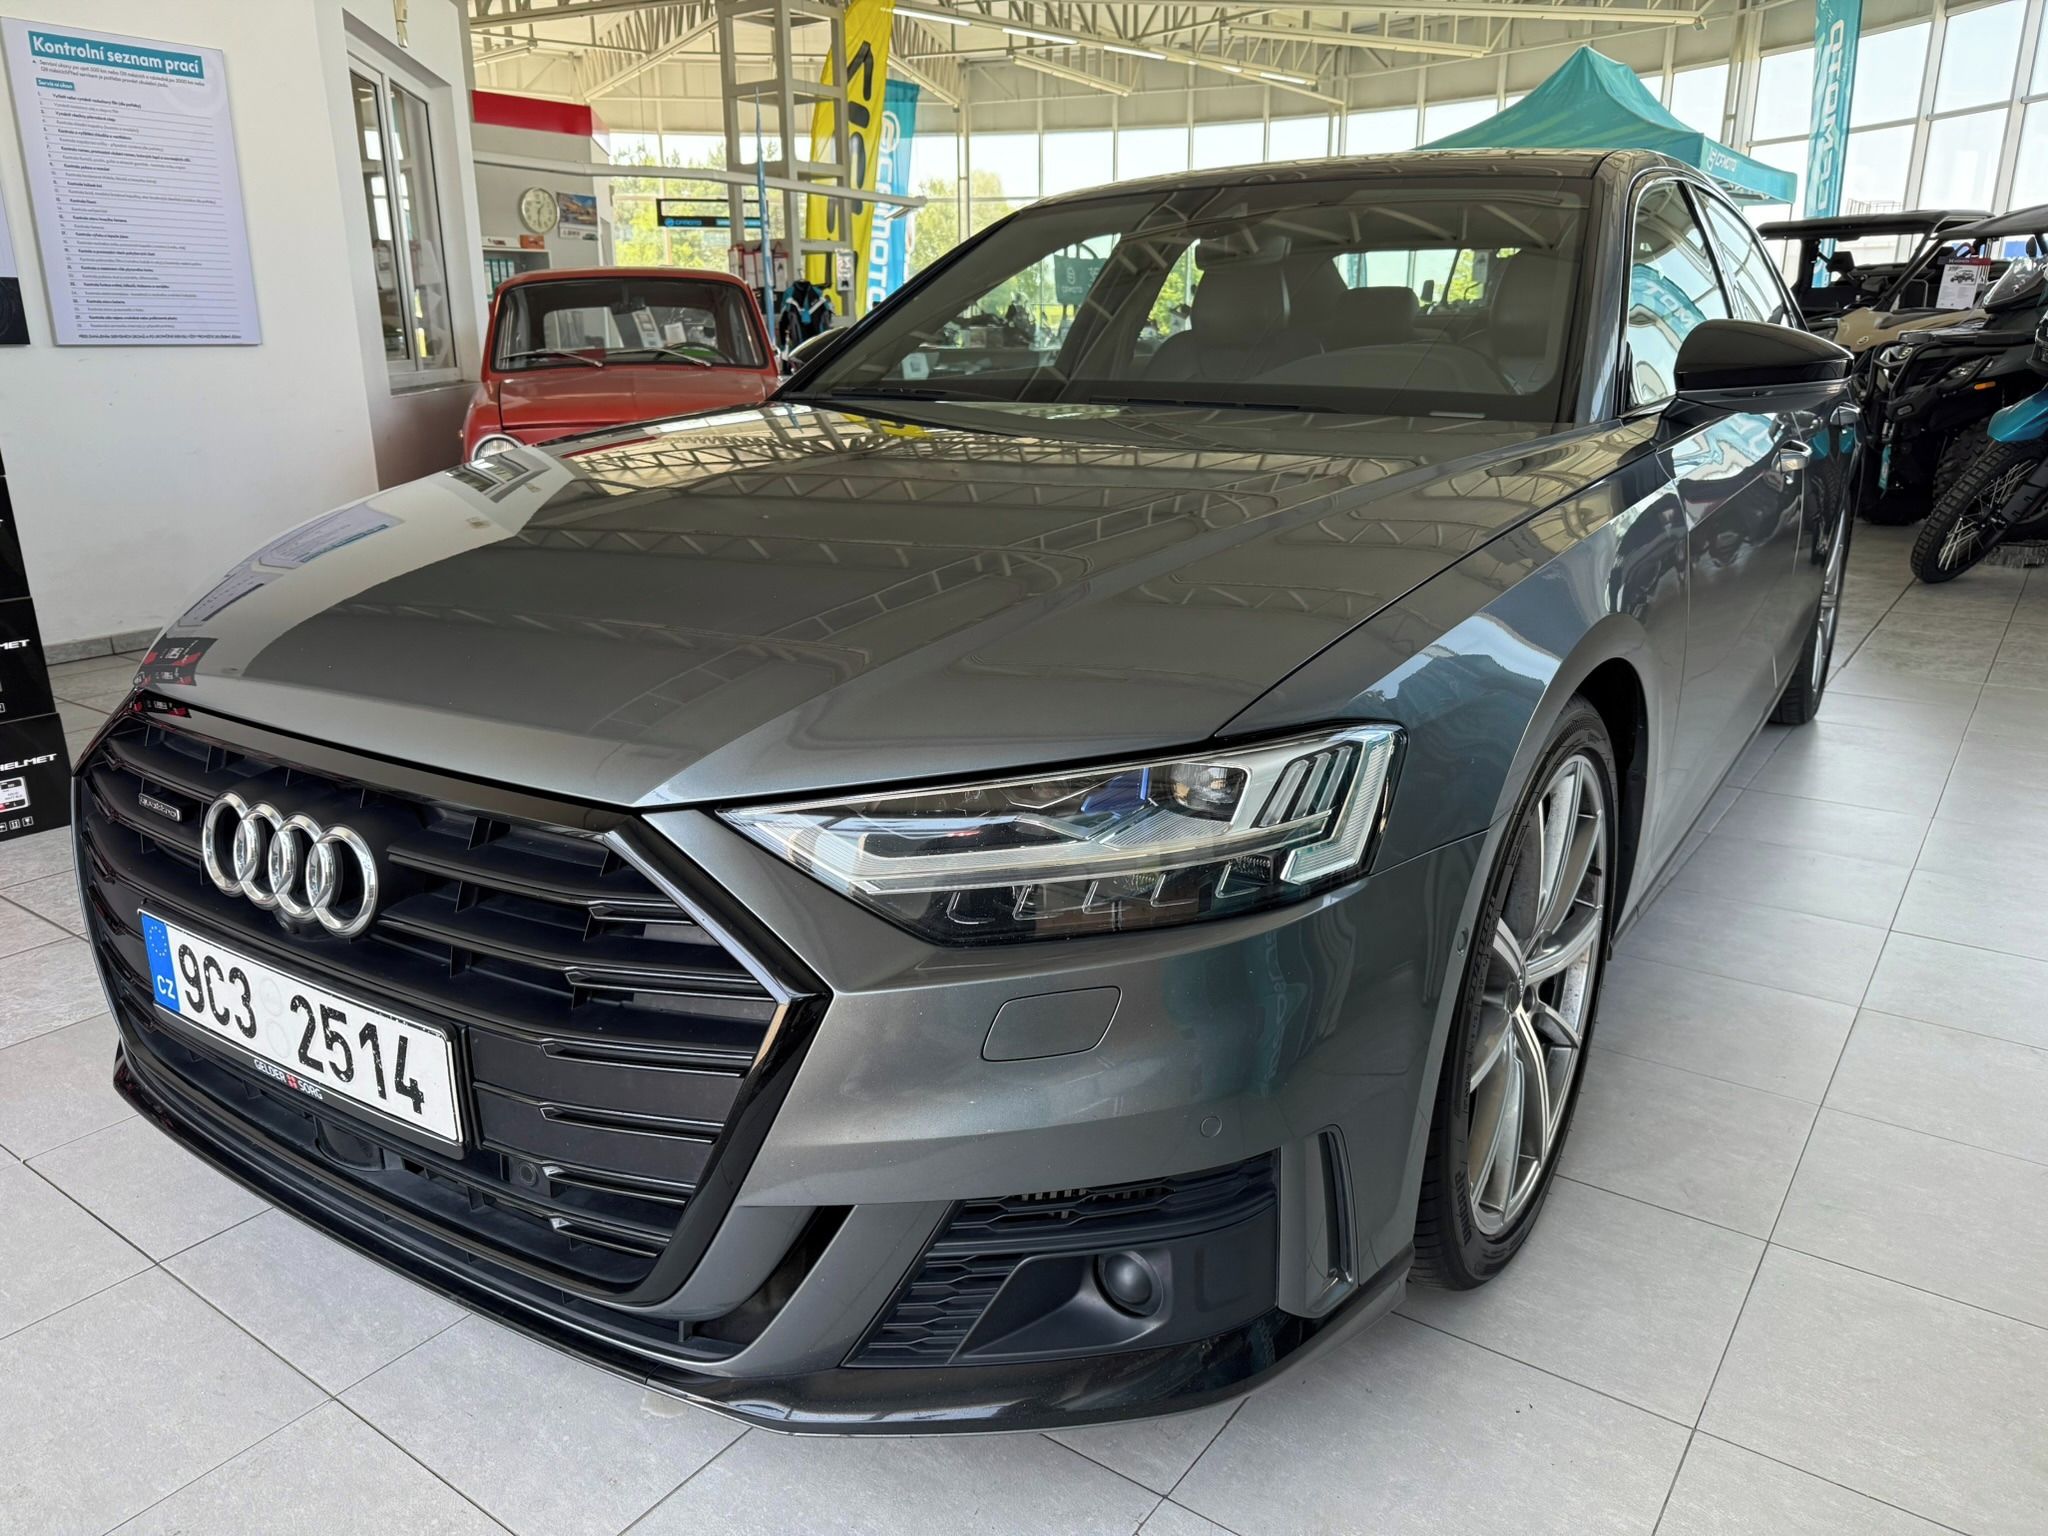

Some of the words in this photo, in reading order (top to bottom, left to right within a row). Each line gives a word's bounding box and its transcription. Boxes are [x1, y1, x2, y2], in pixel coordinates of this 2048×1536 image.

[32, 35, 104, 61] Kontrolní
[107, 50, 163, 69] seznam
[165, 59, 199, 74] prací
[156, 974, 177, 1000] CZ
[178, 943, 257, 1040] 9C3
[289, 994, 425, 1115] 2514
[297, 1079, 324, 1100] SORG
